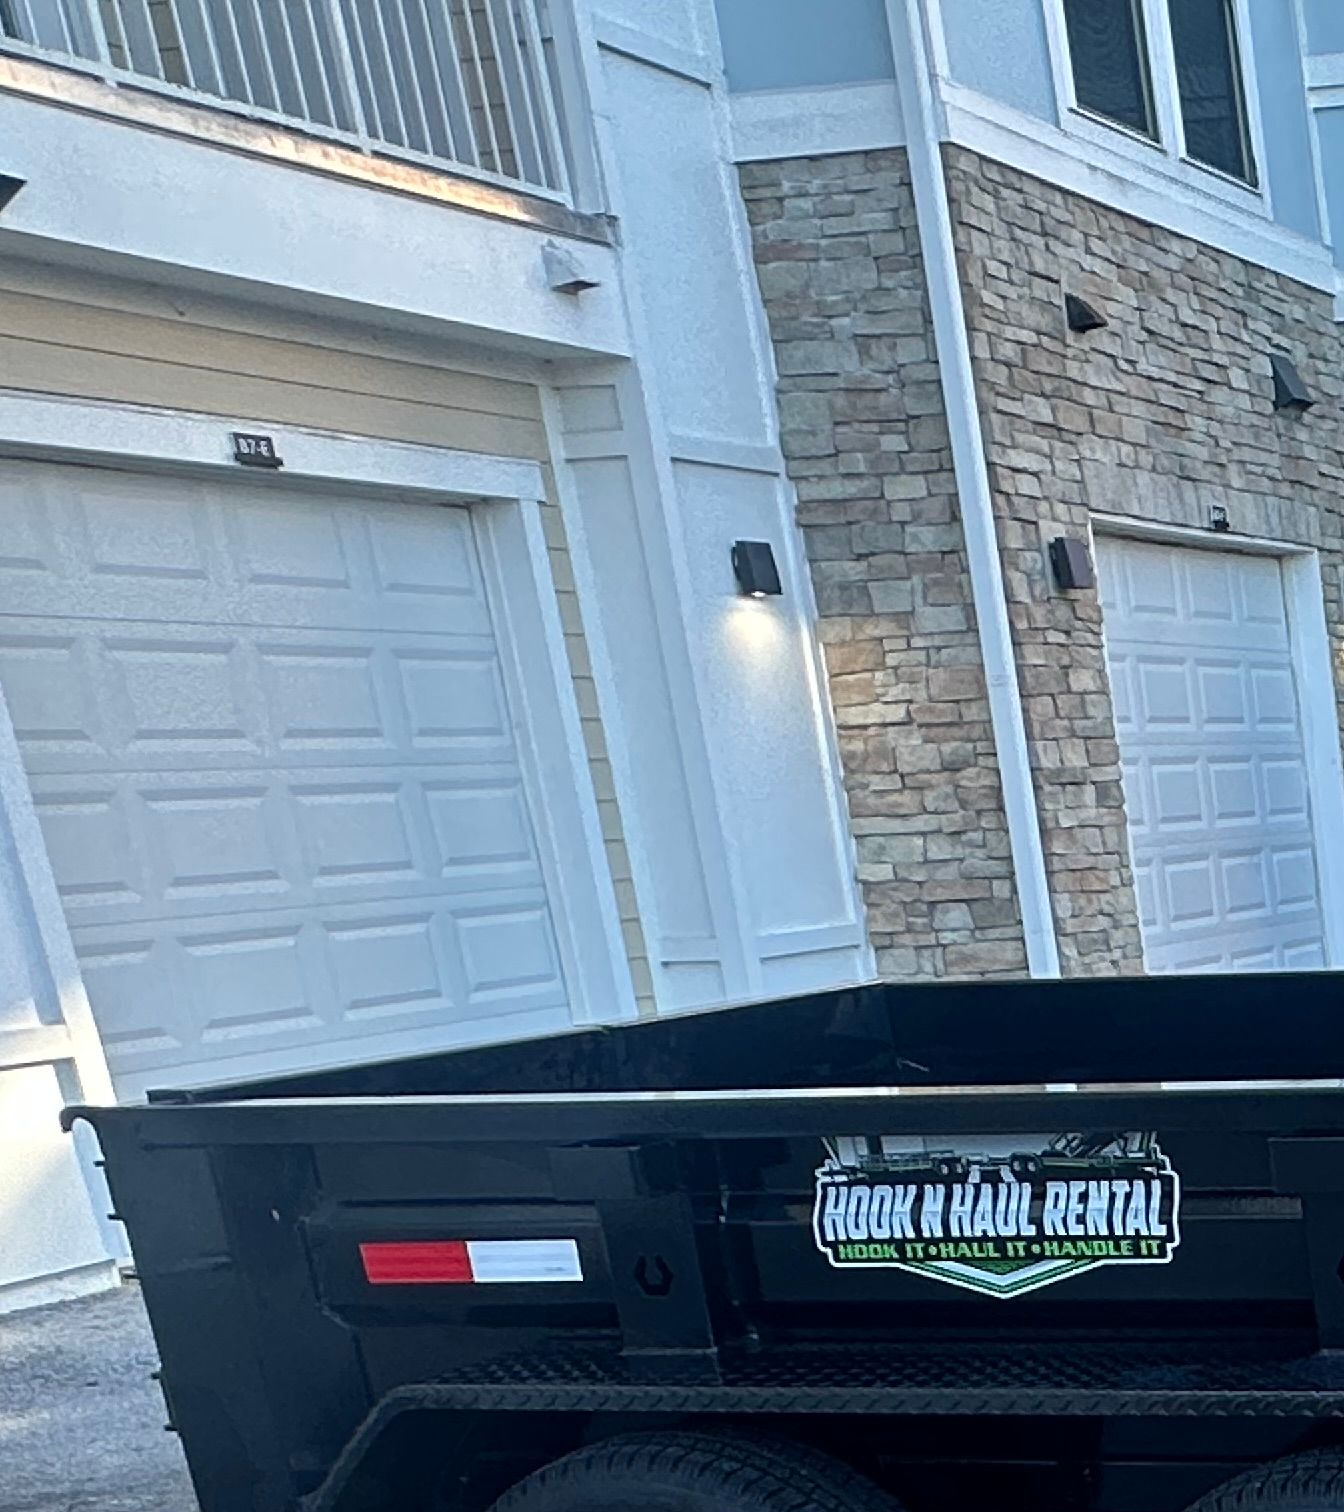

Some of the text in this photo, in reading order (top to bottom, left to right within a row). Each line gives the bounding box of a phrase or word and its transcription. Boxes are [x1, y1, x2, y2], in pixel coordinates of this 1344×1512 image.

[823, 1180, 1168, 1241] HOOK N HAUL RENTAL
[839, 1240, 1162, 1260] HOOK IT HAUL IT HANDLE IT
